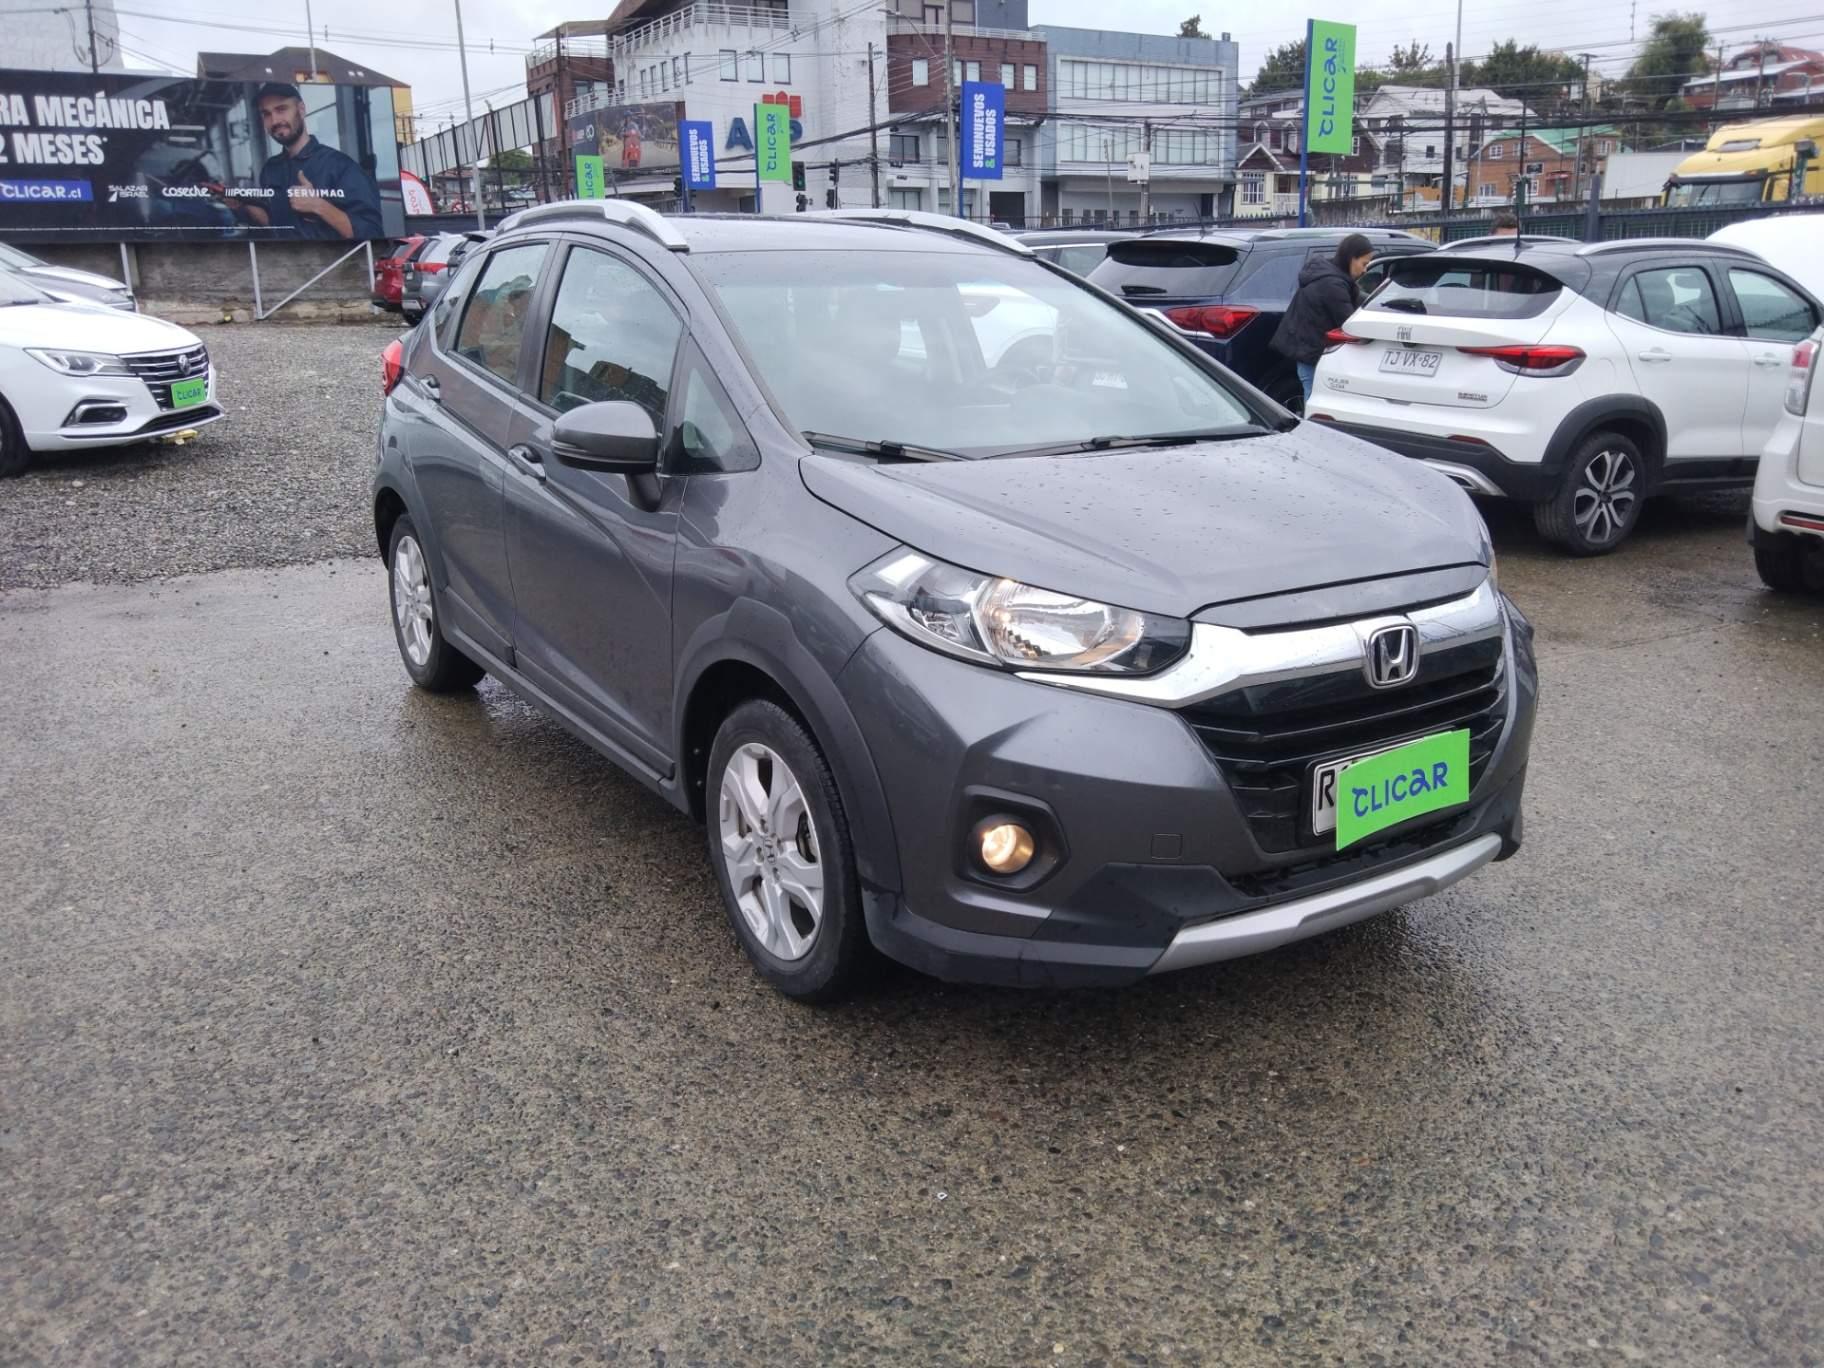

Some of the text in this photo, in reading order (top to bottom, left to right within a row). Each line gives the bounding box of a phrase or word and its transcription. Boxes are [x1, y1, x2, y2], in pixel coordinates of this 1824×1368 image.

[34, 90, 171, 130] MECÁNICA
[973, 93, 985, 168] SEMINUEVOS
[688, 128, 701, 182] SEMINUEVOS
[699, 139, 710, 174] USADOS
[985, 109, 997, 169] & USADOS
